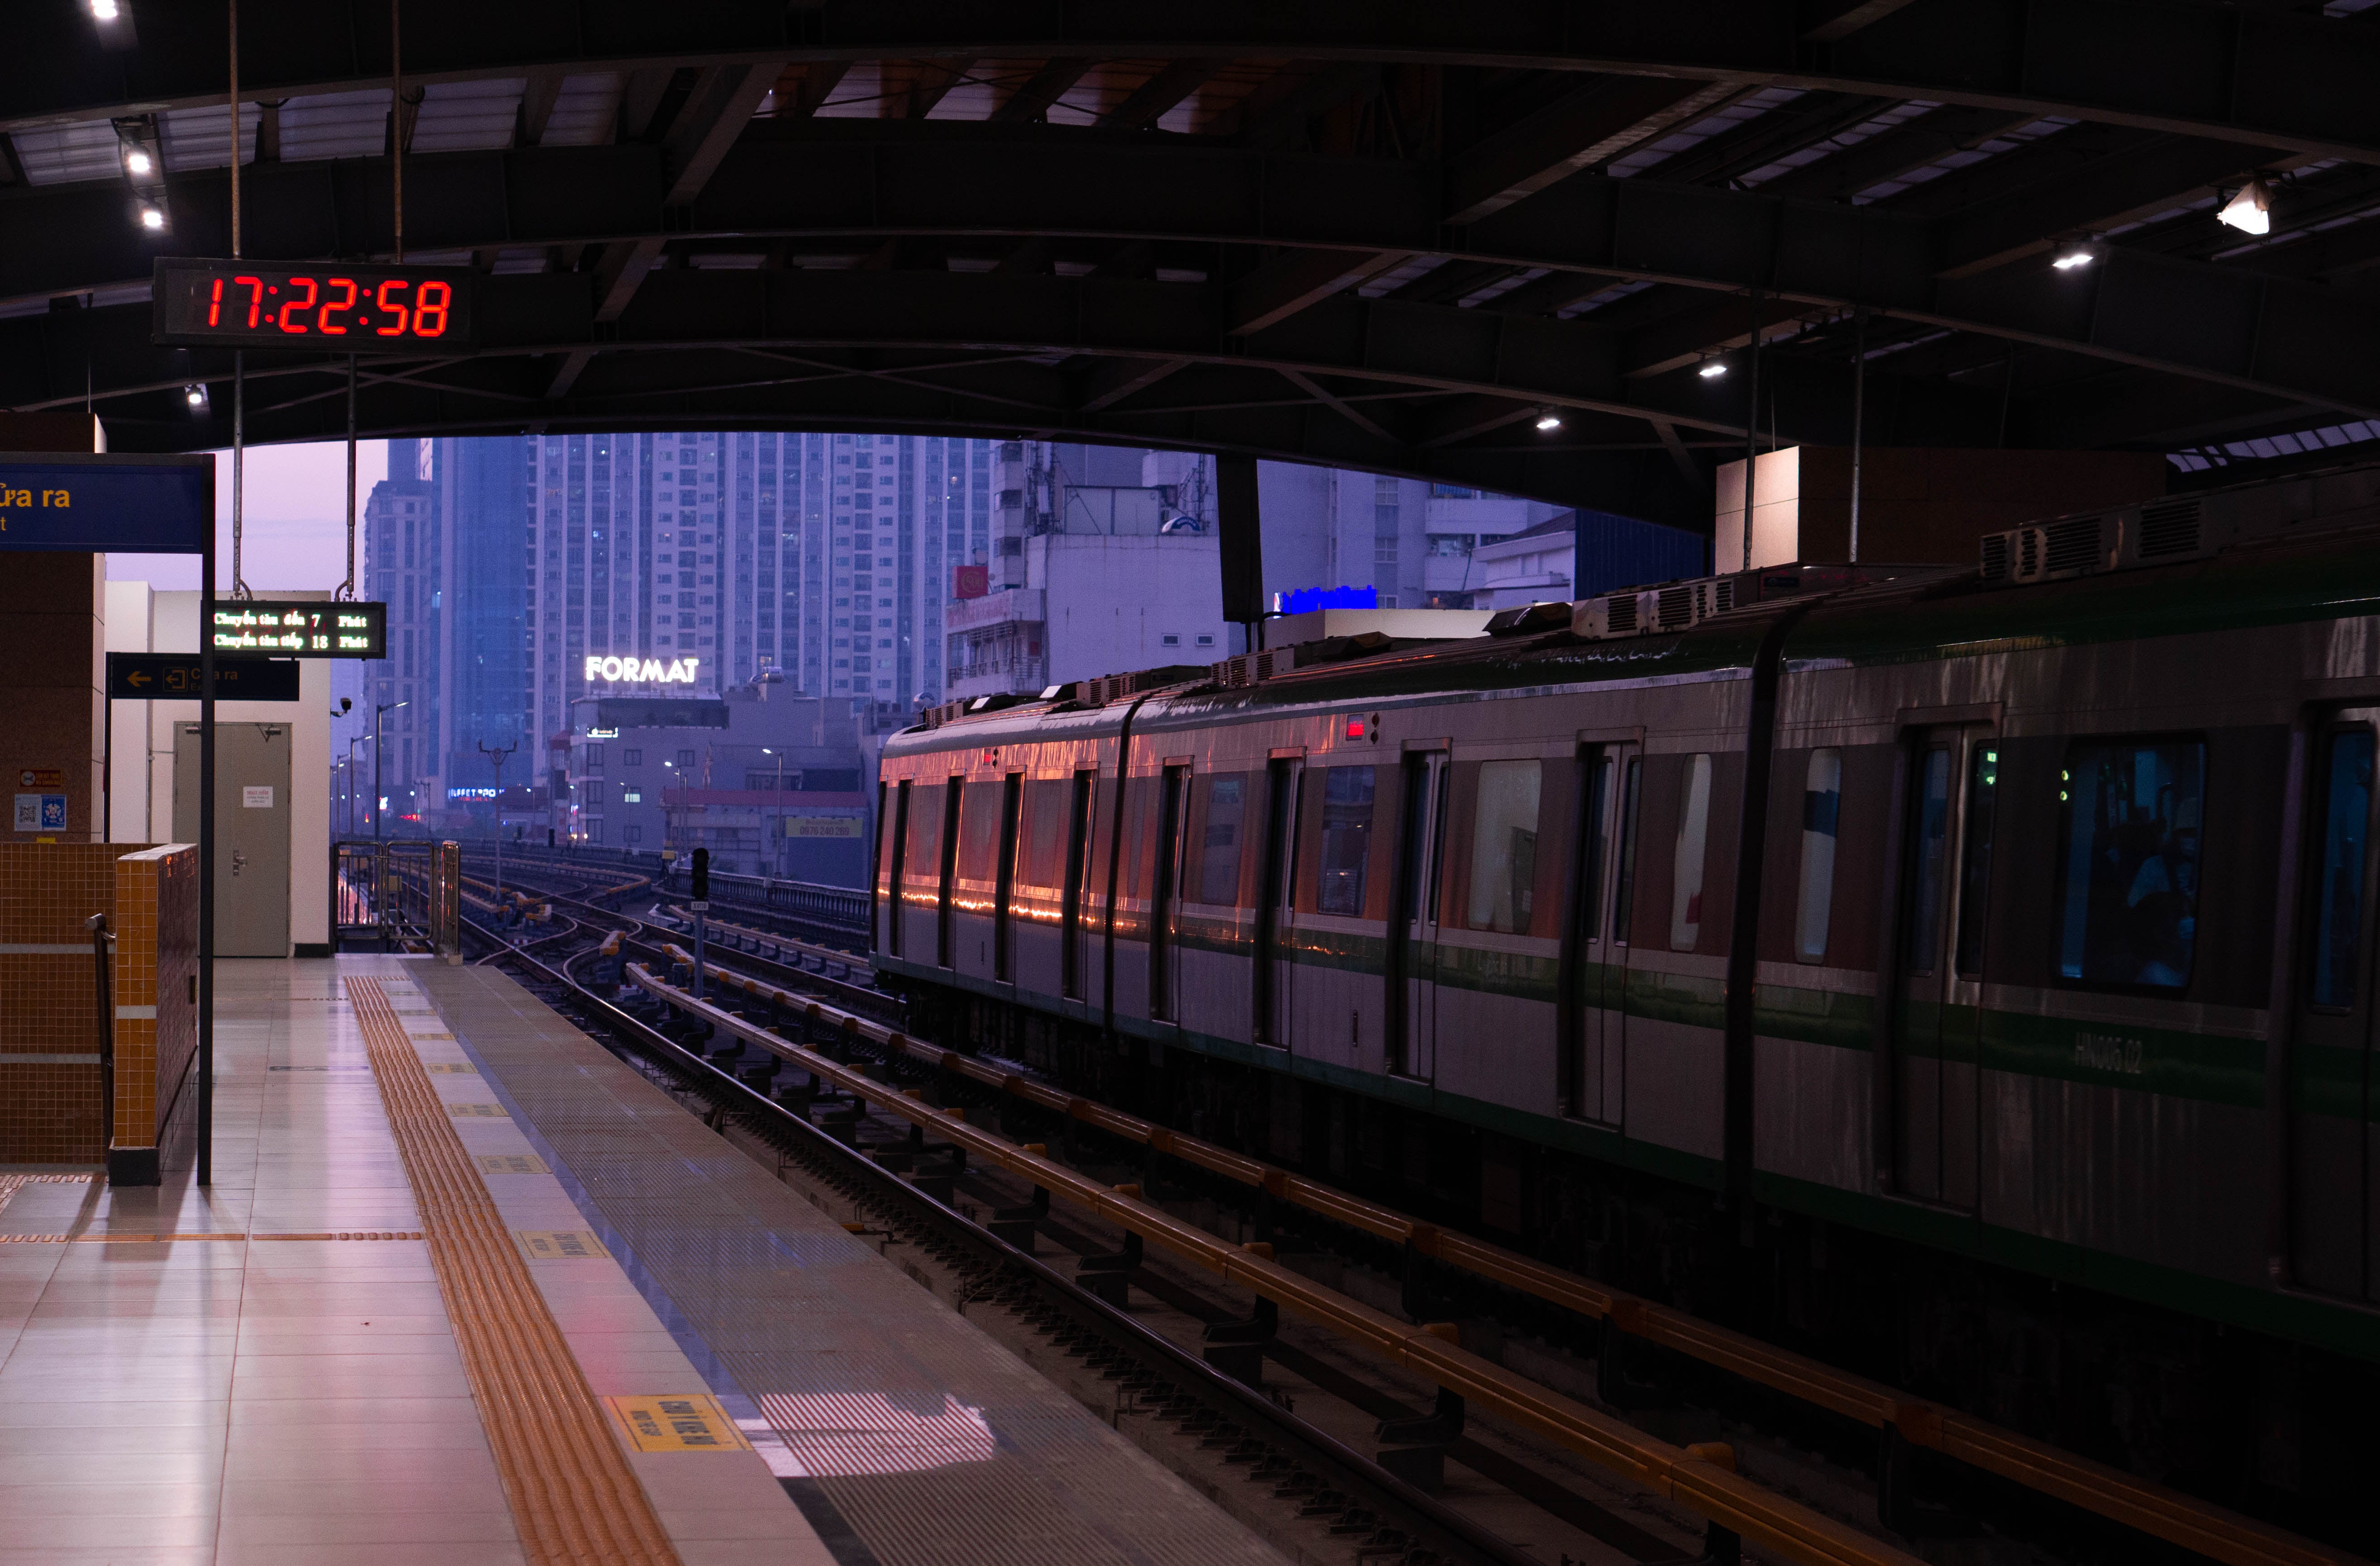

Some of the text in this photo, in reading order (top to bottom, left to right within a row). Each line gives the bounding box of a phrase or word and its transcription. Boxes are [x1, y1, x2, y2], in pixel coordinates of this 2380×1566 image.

[209, 276, 452, 337] 17:22:58
[42, 489, 71, 508] ra
[311, 614, 321, 627] 7
[338, 615, 367, 627] Phút
[312, 636, 328, 649] 18
[339, 636, 368, 648] Phút
[224, 670, 238, 681] ra
[586, 656, 700, 683] FORMAT
